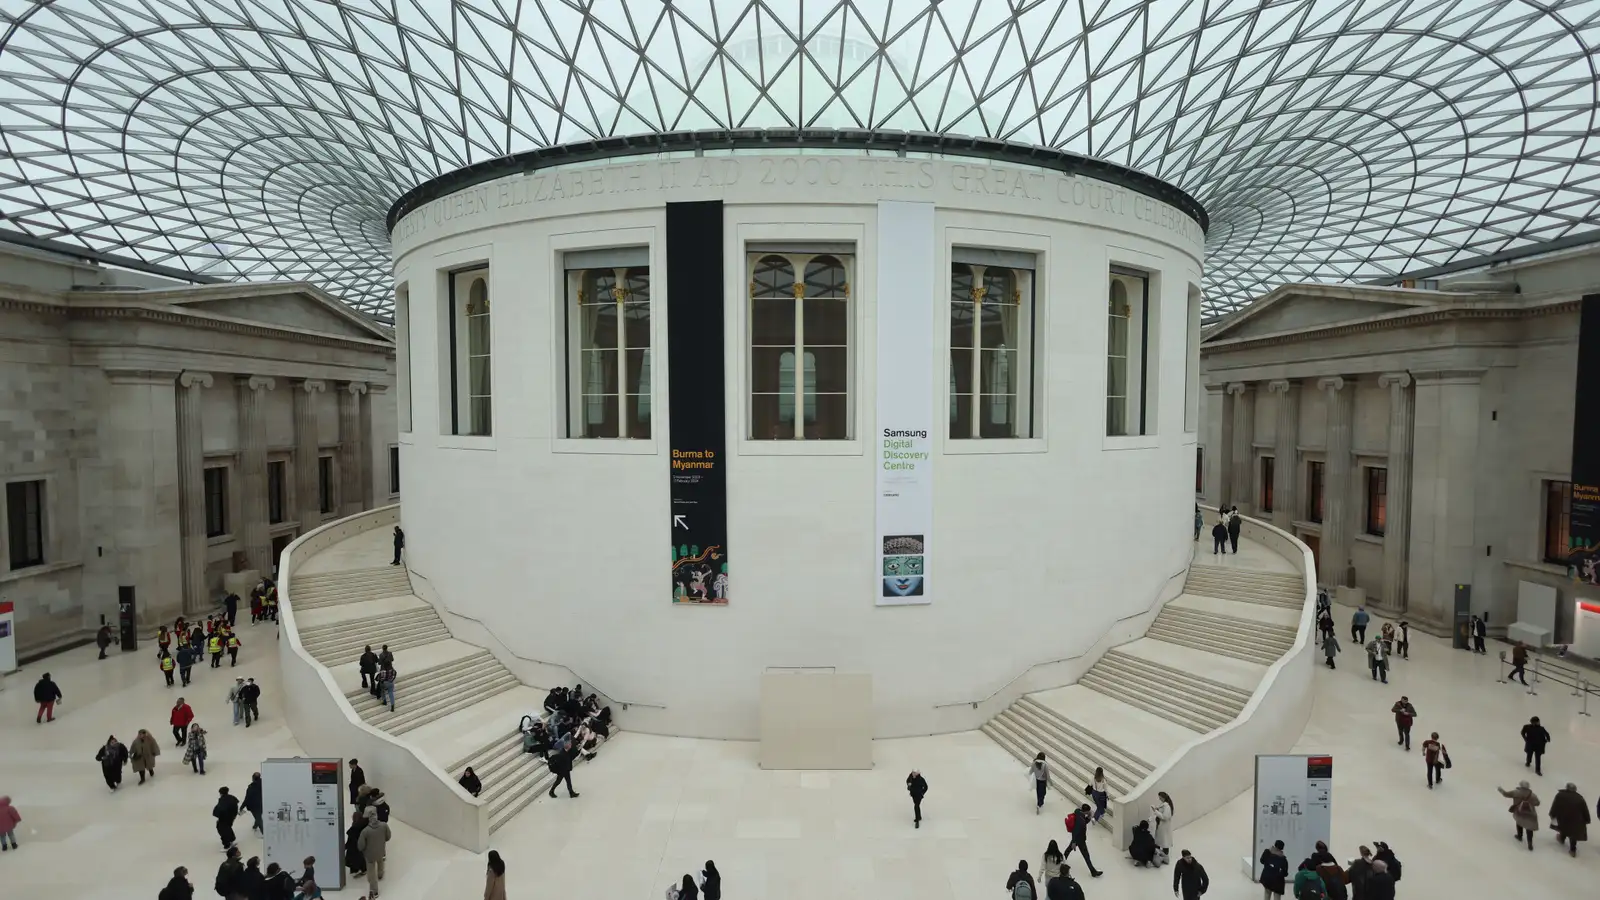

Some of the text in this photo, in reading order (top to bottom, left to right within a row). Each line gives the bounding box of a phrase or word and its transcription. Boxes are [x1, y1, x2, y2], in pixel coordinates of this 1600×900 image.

[433, 185, 488, 227] QUEEN
[497, 163, 648, 209] ELIZABETH
[657, 160, 681, 190] II
[693, 157, 743, 187] AD
[759, 157, 843, 187] 2000
[858, 159, 935, 190] THIS
[951, 164, 1045, 201] GREAT
[1056, 178, 1128, 216] COURT
[883, 428, 927, 439] Samsung
[883, 439, 913, 450] Digital
[673, 450, 714, 458] Burma to
[883, 450, 929, 461] Discovery
[673, 460, 714, 470] Myanmar
[883, 461, 915, 470] Centre
[1574, 484, 1598, 493] Burma
